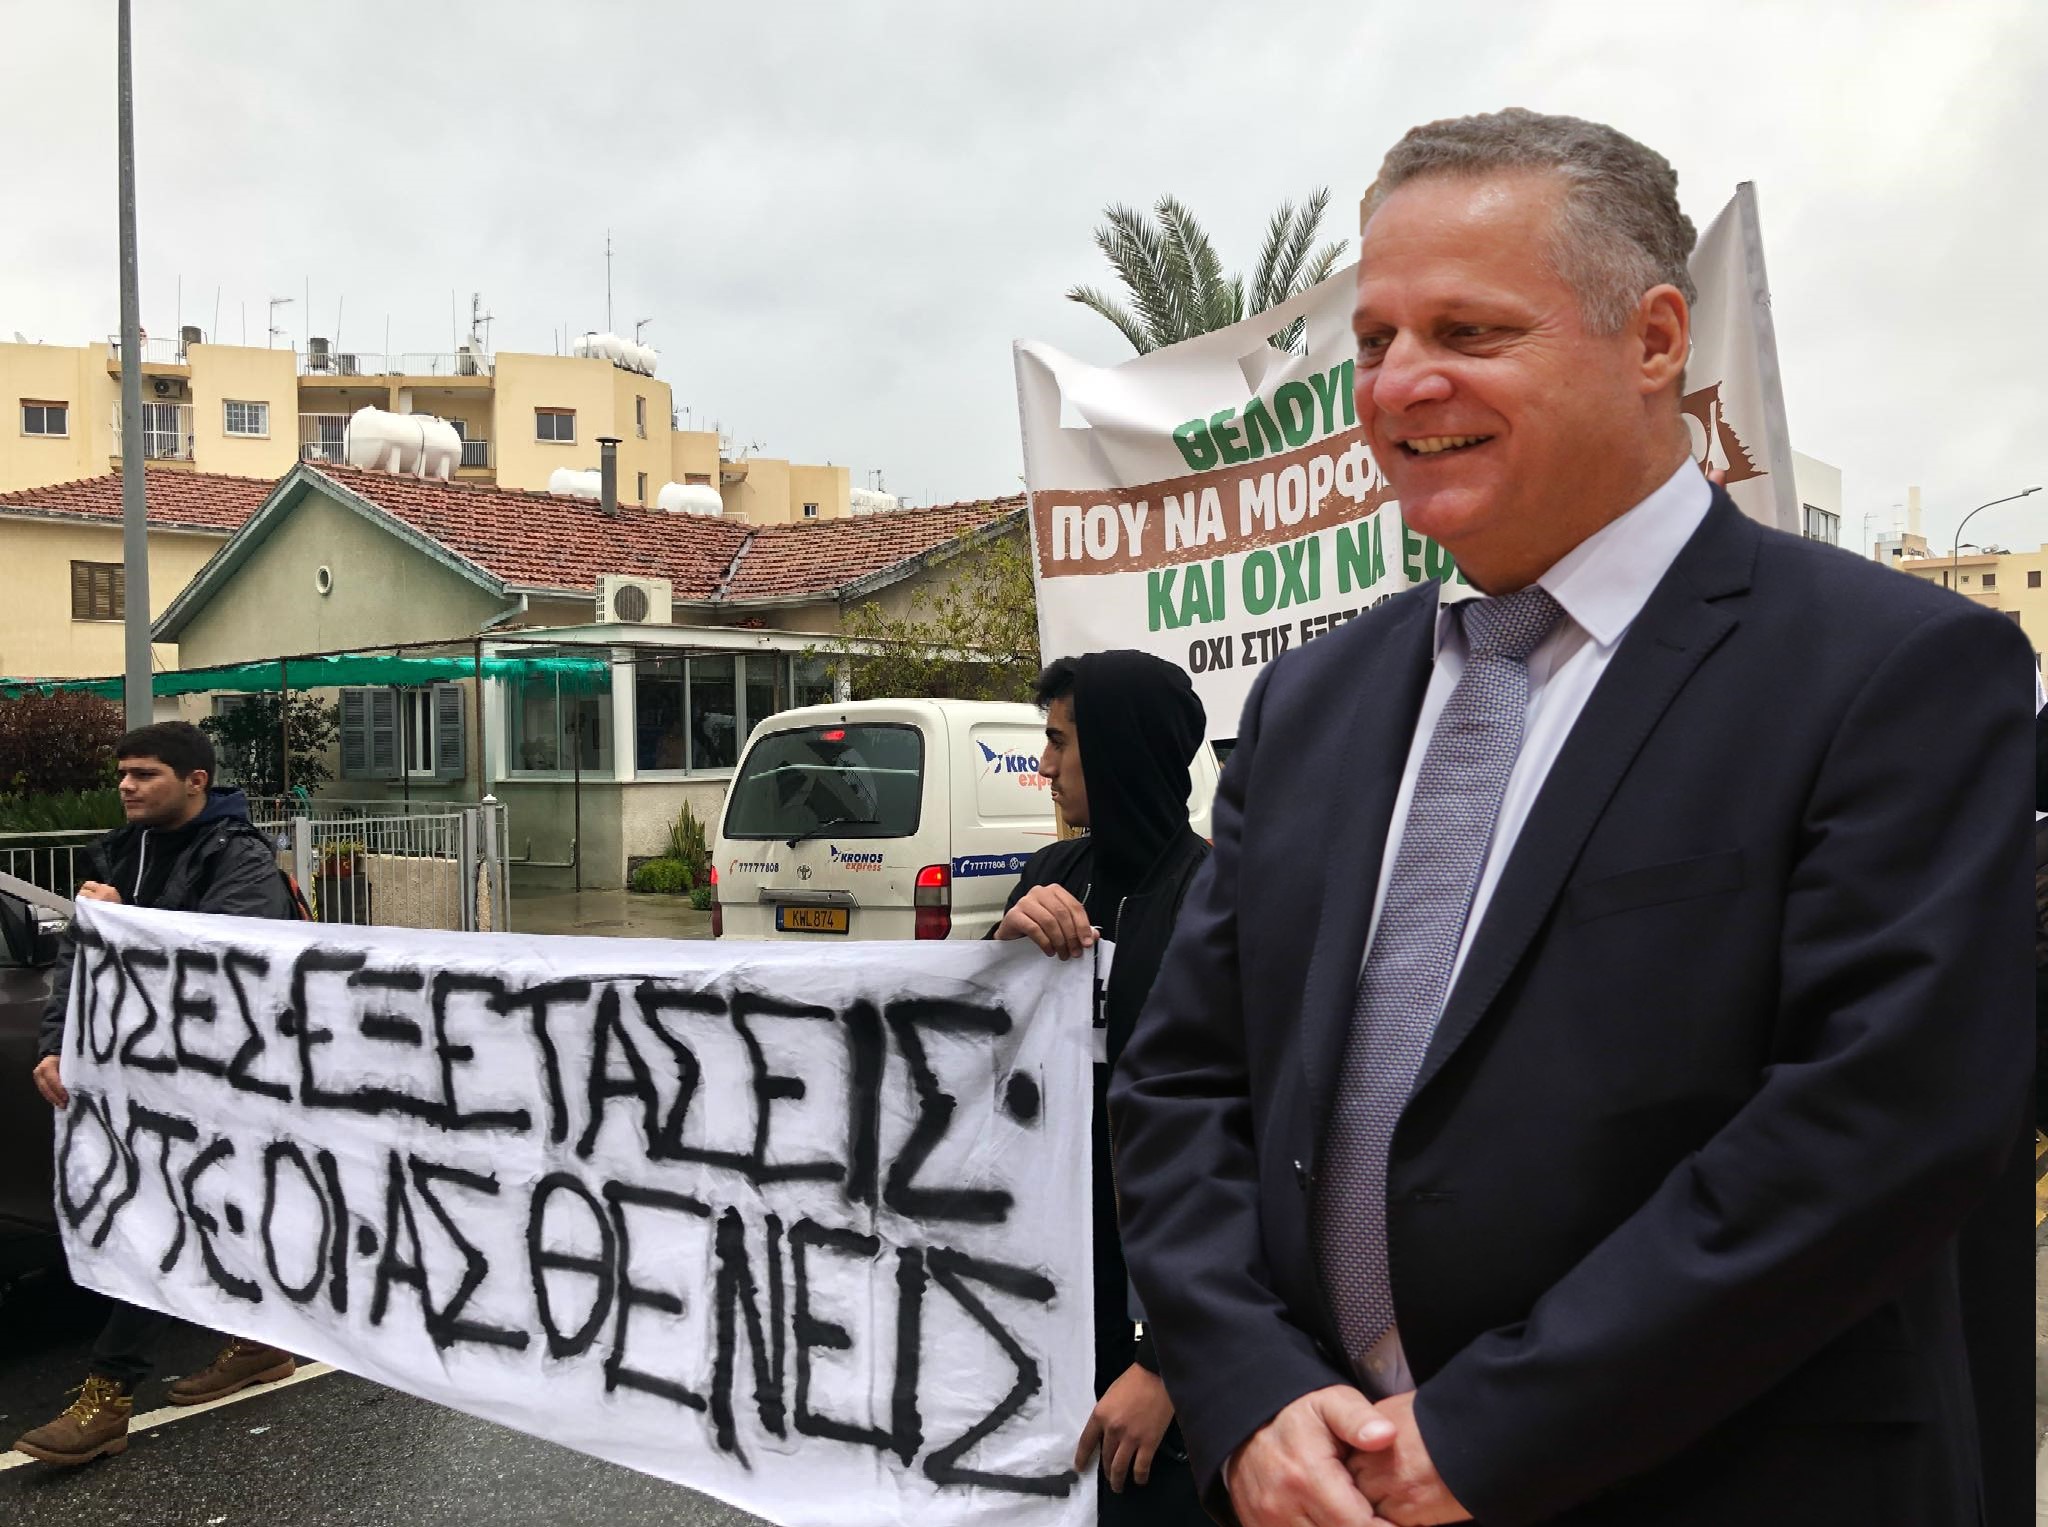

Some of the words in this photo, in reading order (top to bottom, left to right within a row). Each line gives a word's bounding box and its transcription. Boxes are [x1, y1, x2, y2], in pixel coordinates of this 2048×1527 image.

[1051, 502, 1149, 561] ΠΟΥ
[1163, 486, 1227, 551] ΝΑ
[1239, 440, 1391, 537] ΜΟΡΦ
[1147, 561, 1226, 631] ΚΑΙ
[1241, 536, 1322, 616] ΟΧΙ
[1336, 513, 1386, 594] ΝΑ
[1189, 636, 1233, 674] ΟΧΙ
[1241, 623, 1292, 666] ΣΤΙΣ
[1005, 754, 1040, 773] KRO
[840, 853, 883, 863] KRONOS
[845, 862, 882, 872] express
[370, 1149, 1078, 1497] ΑΣΘΕΝΕΙΣ
